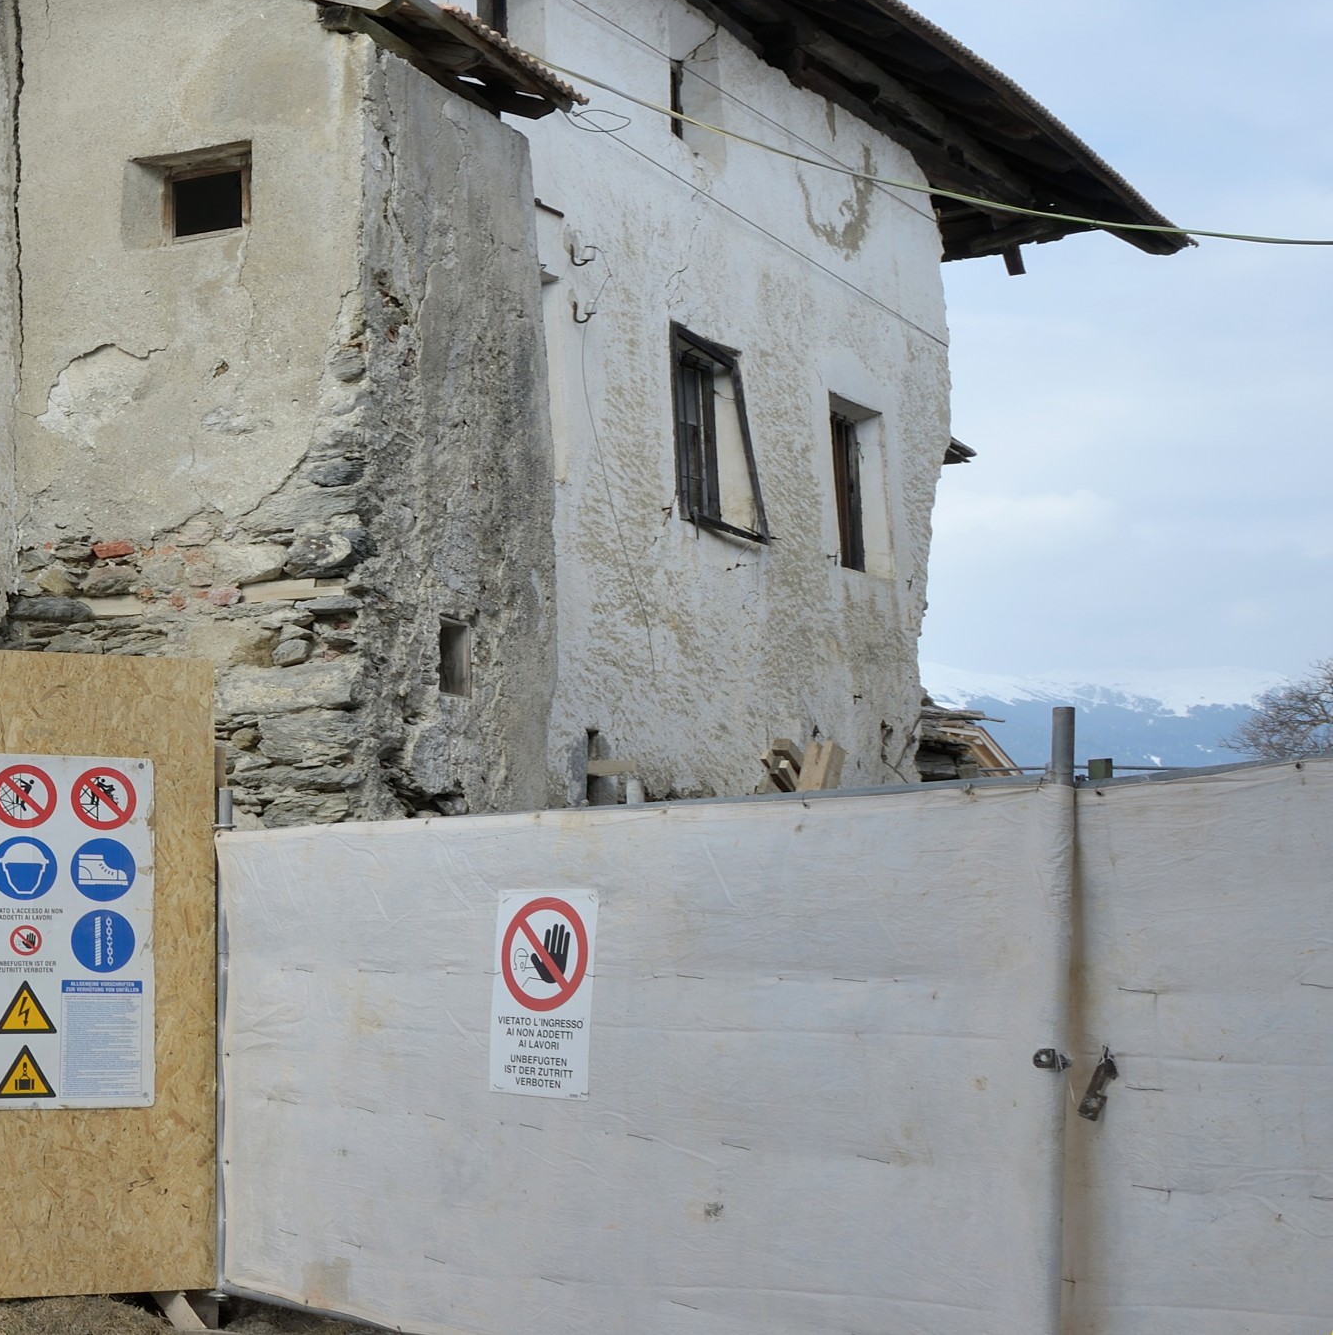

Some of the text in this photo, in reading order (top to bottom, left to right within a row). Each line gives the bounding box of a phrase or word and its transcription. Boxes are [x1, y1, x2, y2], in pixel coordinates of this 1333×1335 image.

[497, 1015, 584, 1029] VIETATO L'INGRESSO
[506, 1027, 573, 1040] AI NON ADDETTI
[518, 1039, 560, 1050] AI LAVORI
[510, 1054, 568, 1067] UNBEFUGTEN
[504, 1064, 574, 1079] IST DER ZUTRITT
[515, 1076, 561, 1089] VERBOTEN
